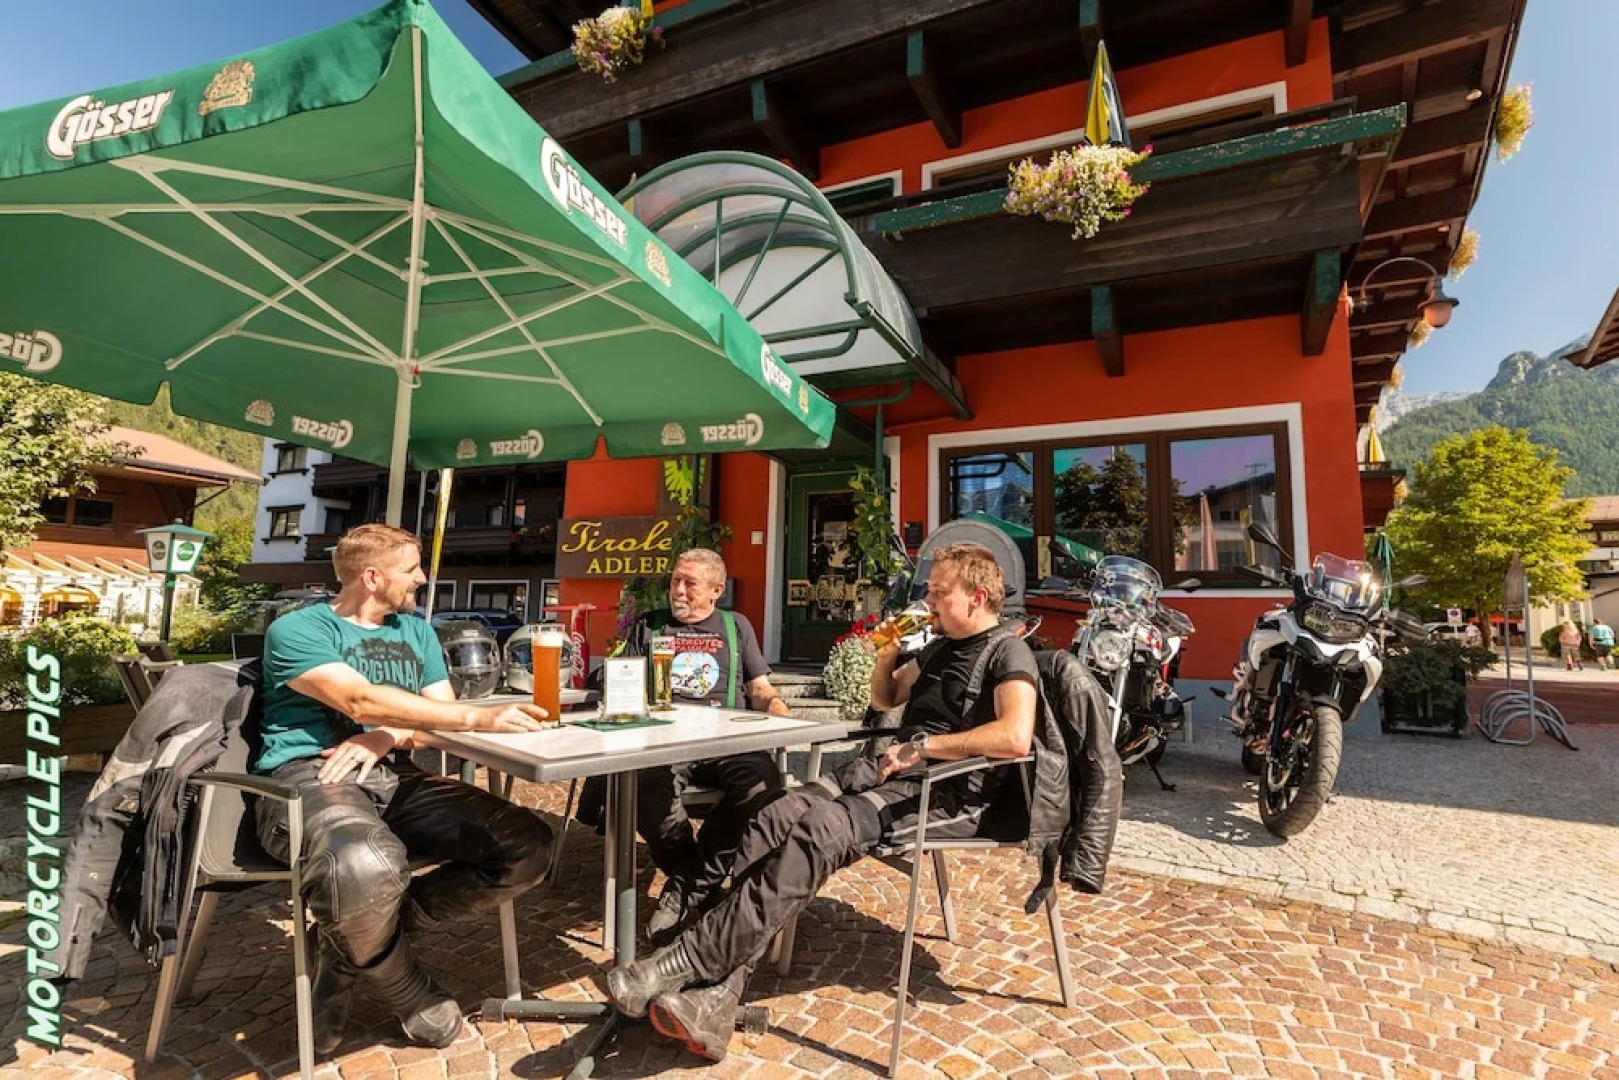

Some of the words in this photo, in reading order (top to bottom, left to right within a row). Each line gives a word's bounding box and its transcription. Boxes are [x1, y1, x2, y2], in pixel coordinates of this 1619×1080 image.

[47, 89, 174, 159] Gösser
[541, 136, 627, 248] Gösser
[562, 520, 672, 552] Tirole
[586, 556, 672, 574] ADLER
